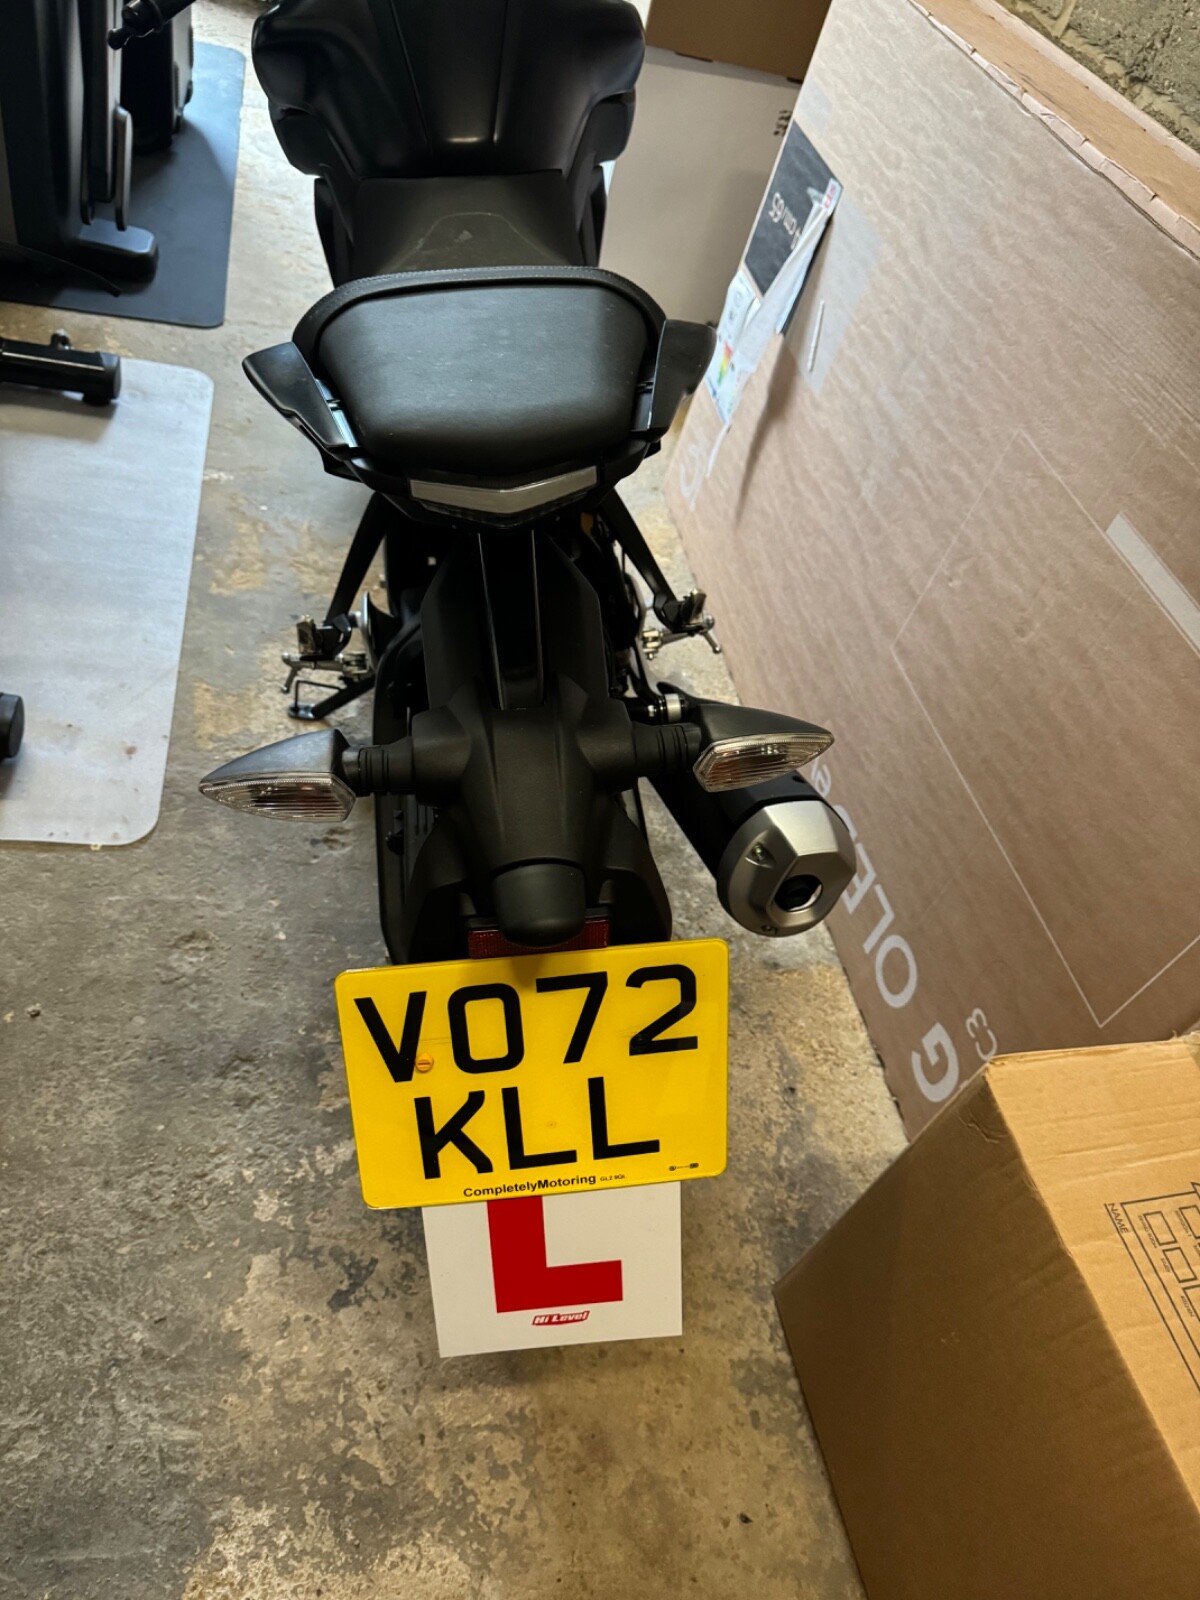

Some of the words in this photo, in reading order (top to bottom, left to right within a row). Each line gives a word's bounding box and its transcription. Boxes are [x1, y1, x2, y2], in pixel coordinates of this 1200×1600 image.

[833, 804, 918, 1008] OLE
[353, 963, 698, 1083] VO72
[911, 1022, 970, 1103] G
[966, 1008, 998, 1061] C3
[414, 1076, 660, 1180] KLL
[463, 1175, 597, 1197] CompletelyMotoring
[1108, 1203, 1129, 1233] NAME
[486, 1195, 623, 1313] L
[534, 1315, 550, 1324] Hi
[551, 1311, 589, 1322] Level
